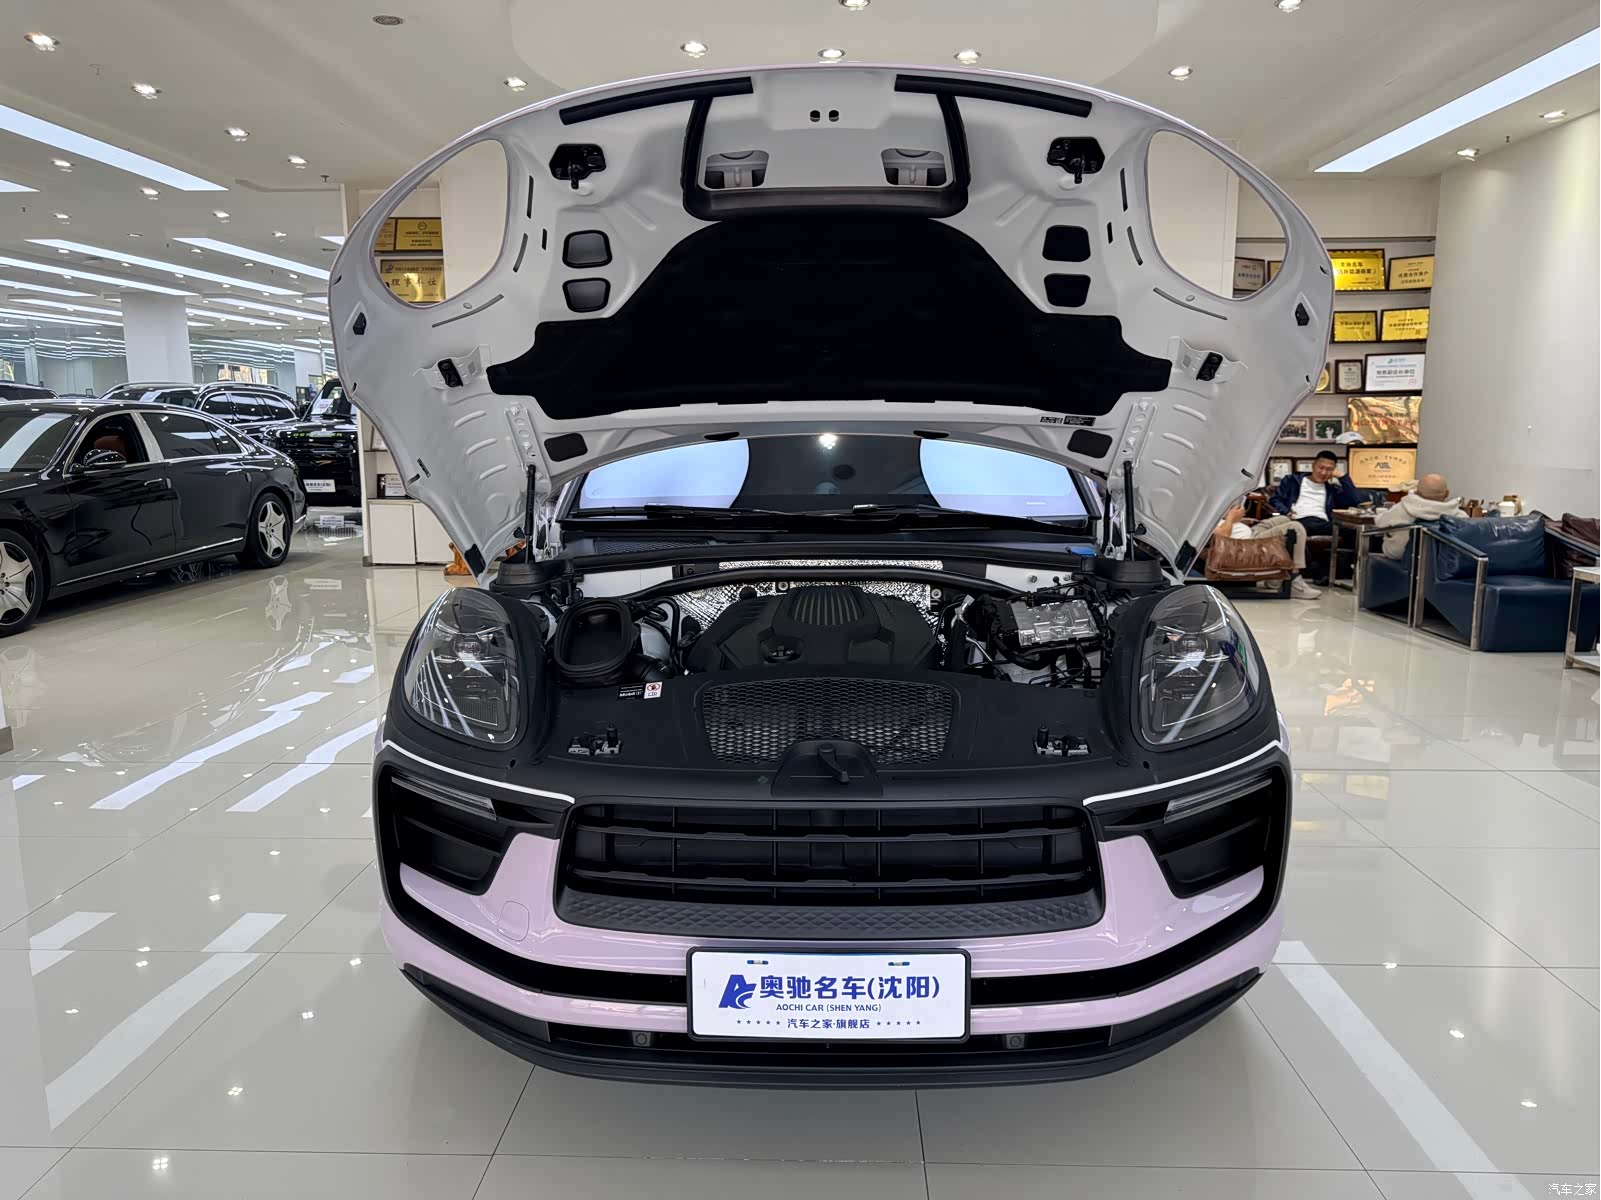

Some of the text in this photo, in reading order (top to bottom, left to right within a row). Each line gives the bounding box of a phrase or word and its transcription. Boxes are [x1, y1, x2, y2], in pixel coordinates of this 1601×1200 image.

[760, 975, 940, 999] 奥驰名车(沈阳)
[776, 1003, 882, 1012] AOCHI CAR (SHEN YANG)
